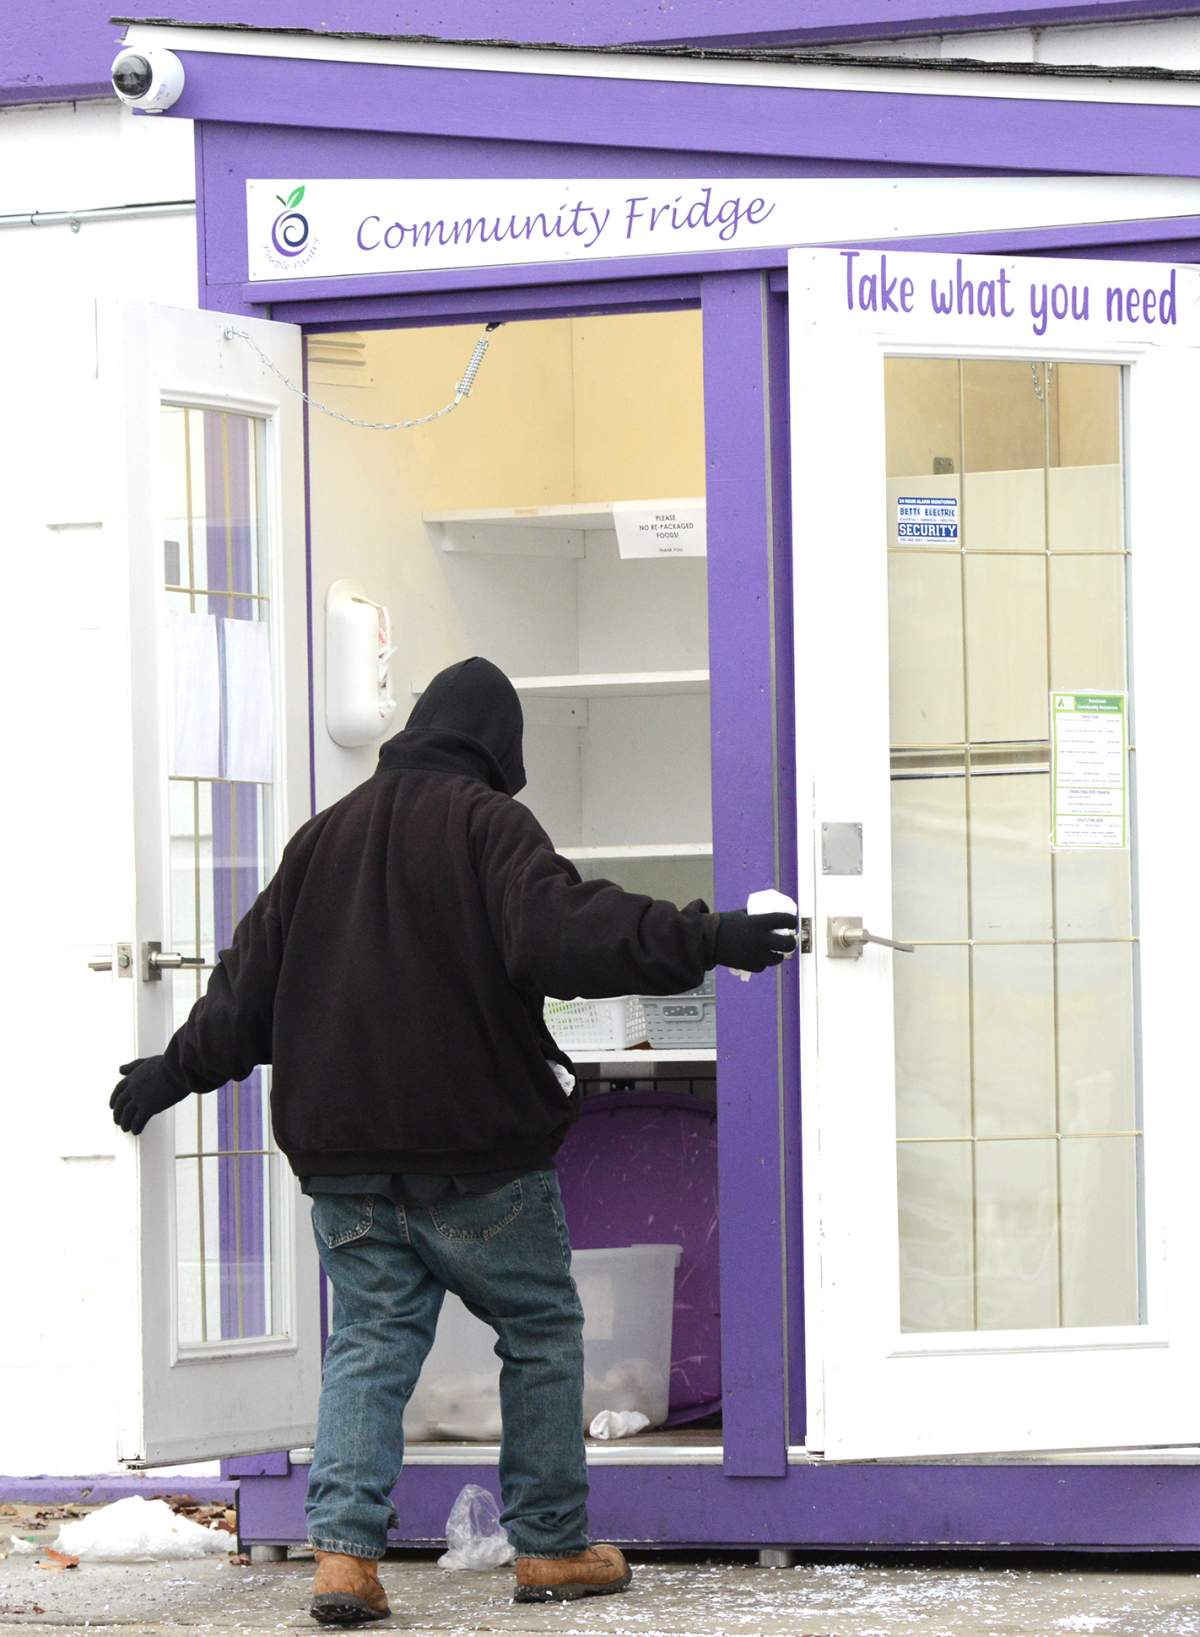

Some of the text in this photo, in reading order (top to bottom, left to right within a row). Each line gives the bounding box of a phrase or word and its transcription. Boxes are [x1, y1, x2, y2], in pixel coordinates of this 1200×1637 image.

[357, 188, 776, 251] Community Fridge
[840, 251, 1176, 336] Take what you need
[925, 508, 955, 517] ELECTRIC
[651, 522, 694, 530] RE-PACKAGED
[899, 523, 956, 537] SECURITY
